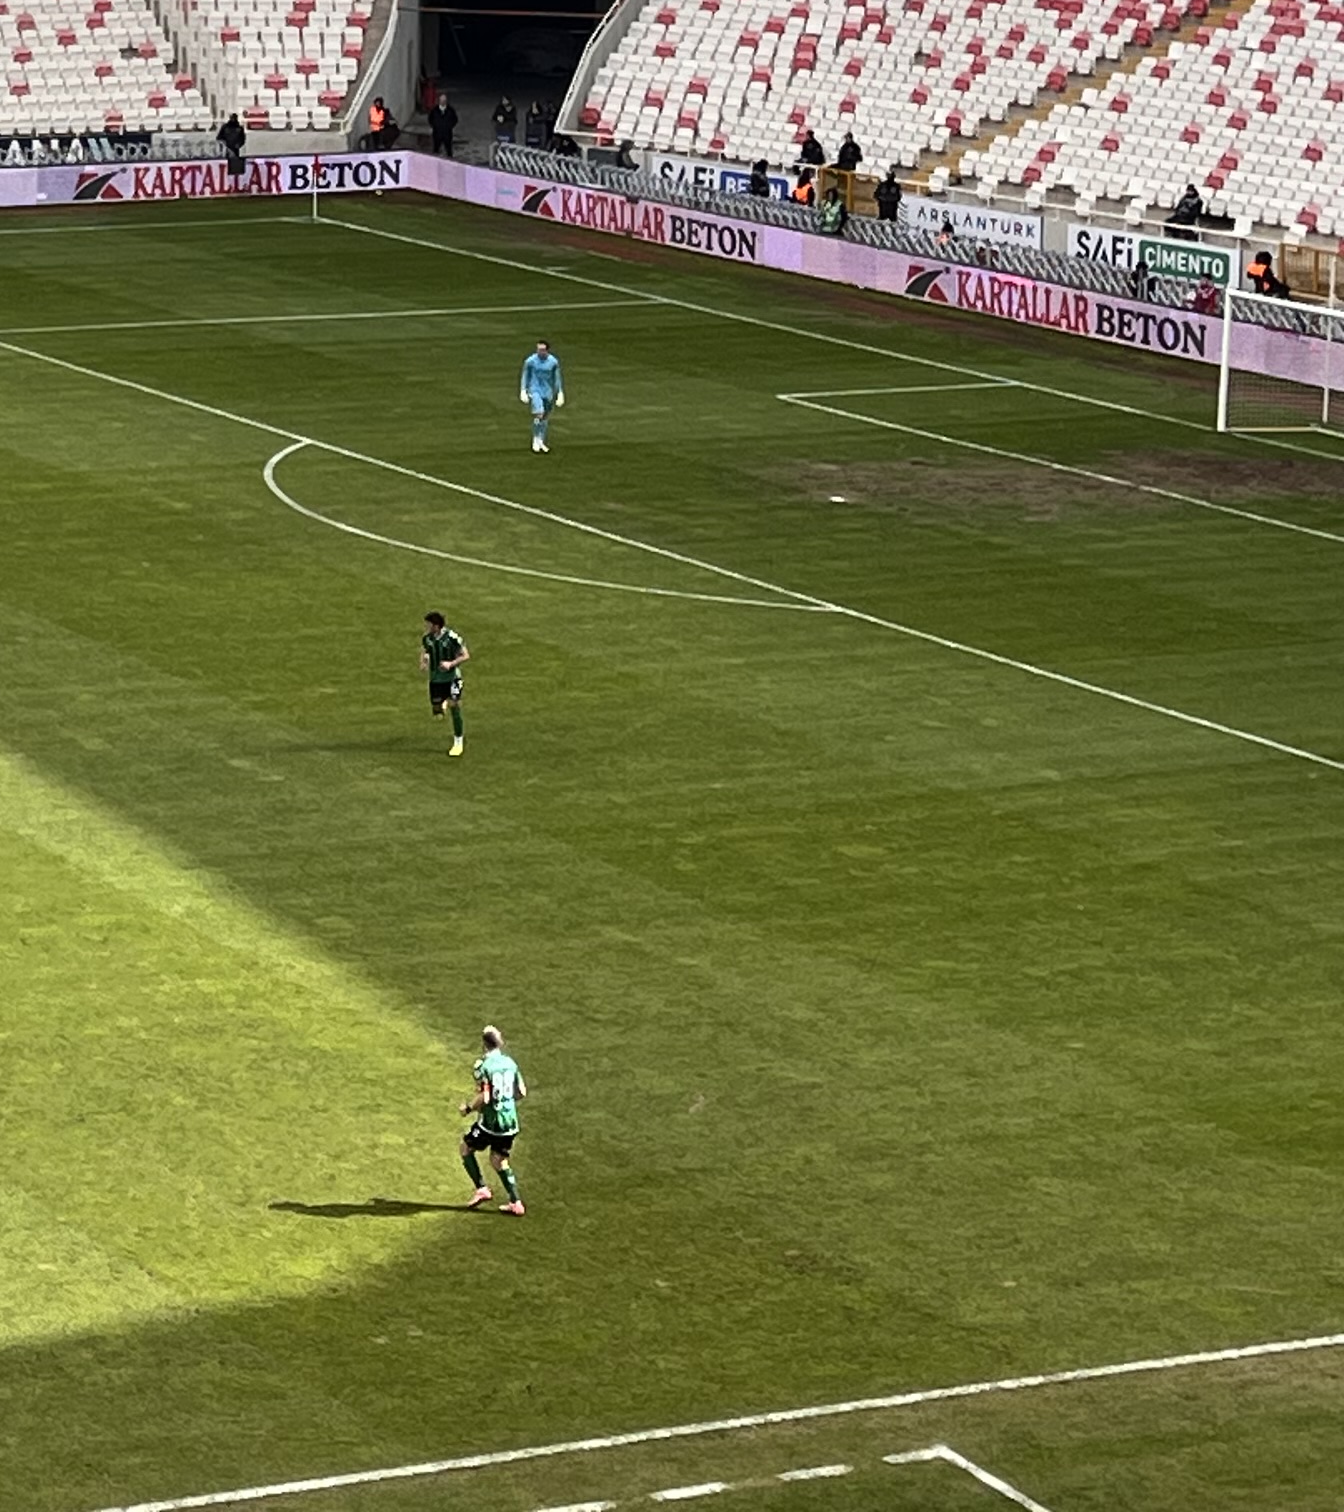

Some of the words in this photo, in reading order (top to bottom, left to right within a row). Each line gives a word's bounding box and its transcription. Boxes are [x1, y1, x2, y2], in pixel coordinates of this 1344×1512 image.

[131, 160, 282, 199] KARTALLAR
[288, 158, 403, 190] BETON
[560, 187, 666, 245] KARTALLAR
[668, 214, 758, 261] BETON
[956, 269, 1090, 335] KARTALLAR
[1094, 301, 1208, 359] BETON
